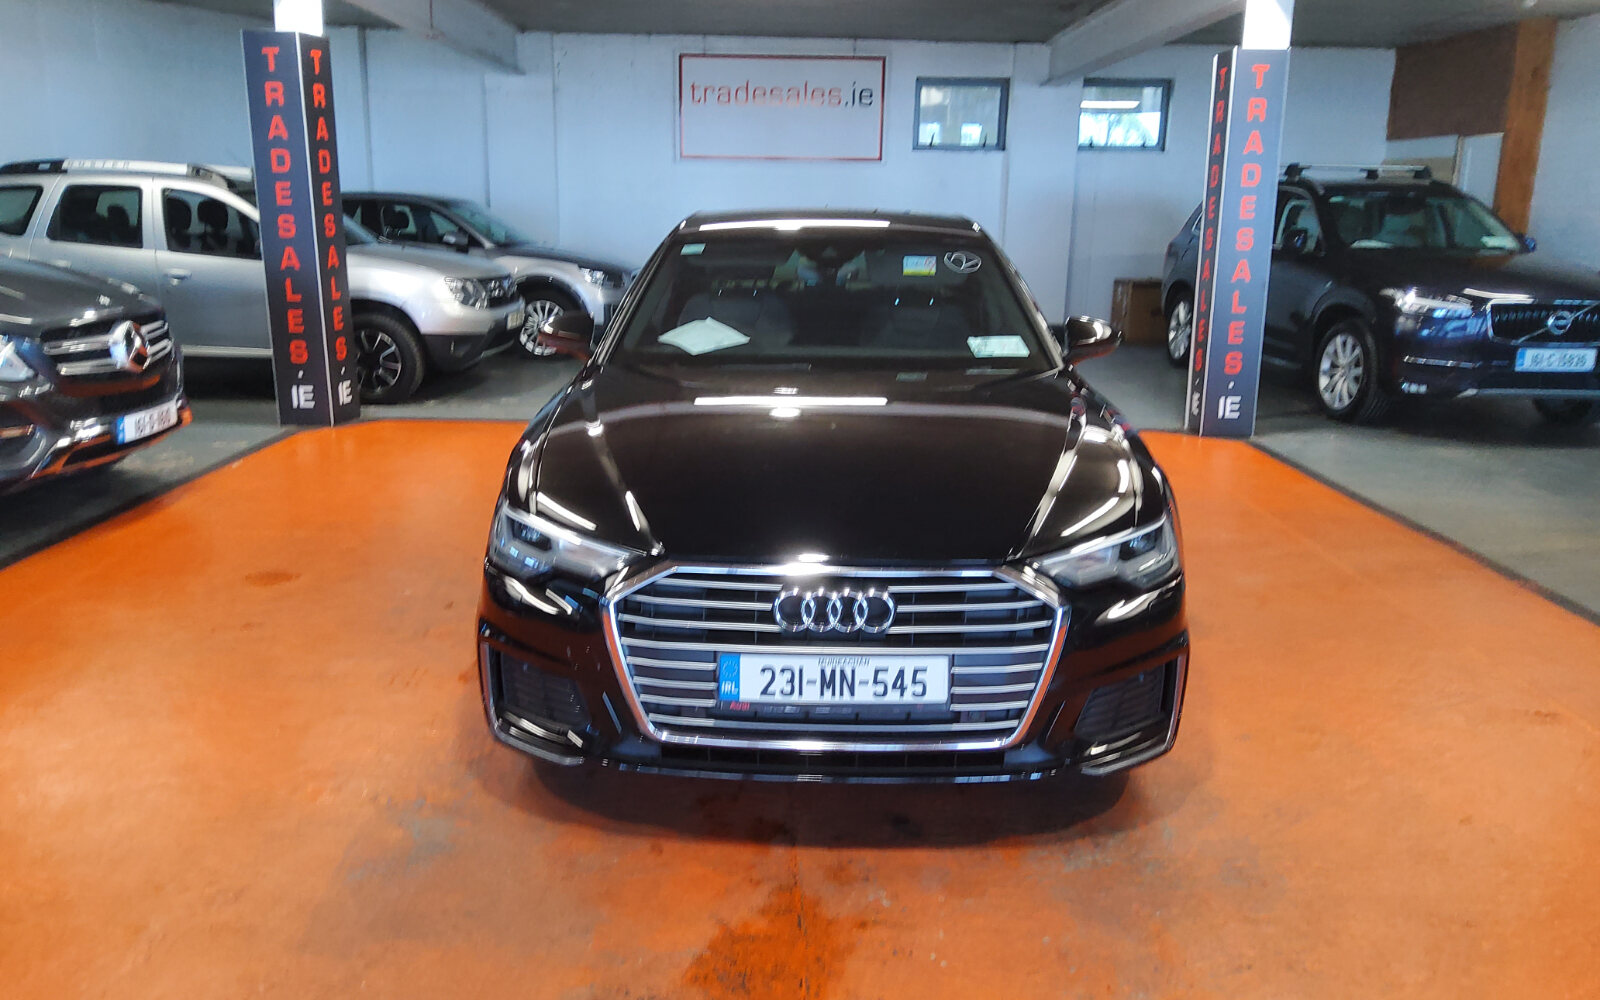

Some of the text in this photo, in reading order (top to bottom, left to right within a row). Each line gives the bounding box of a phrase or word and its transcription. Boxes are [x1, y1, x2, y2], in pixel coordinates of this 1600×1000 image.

[690, 80, 874, 108] tradesales.ie
[721, 681, 739, 696] IRL
[759, 665, 928, 698] 231-MN-545
